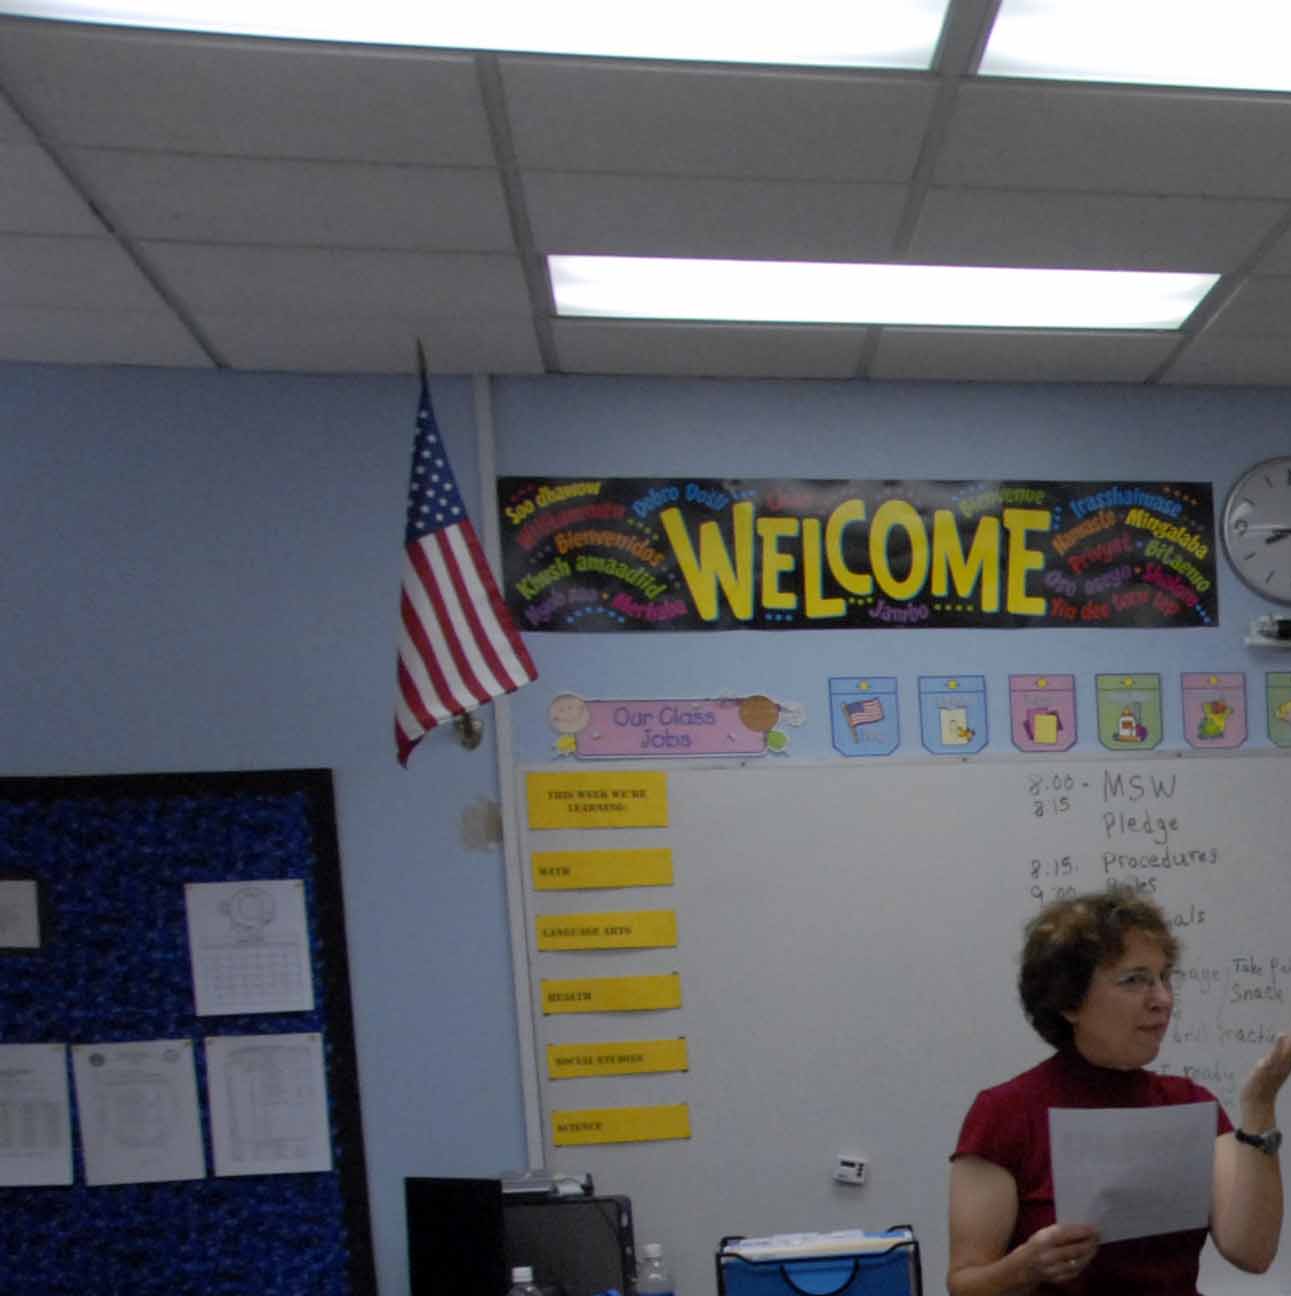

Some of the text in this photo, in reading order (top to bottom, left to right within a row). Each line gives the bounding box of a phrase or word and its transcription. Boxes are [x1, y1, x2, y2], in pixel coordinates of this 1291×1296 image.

[659, 498, 1051, 622] WELCOME
[613, 703, 716, 728] Our Class
[1102, 813, 1180, 845] Pledge
[1103, 848, 1218, 874] Procedures
